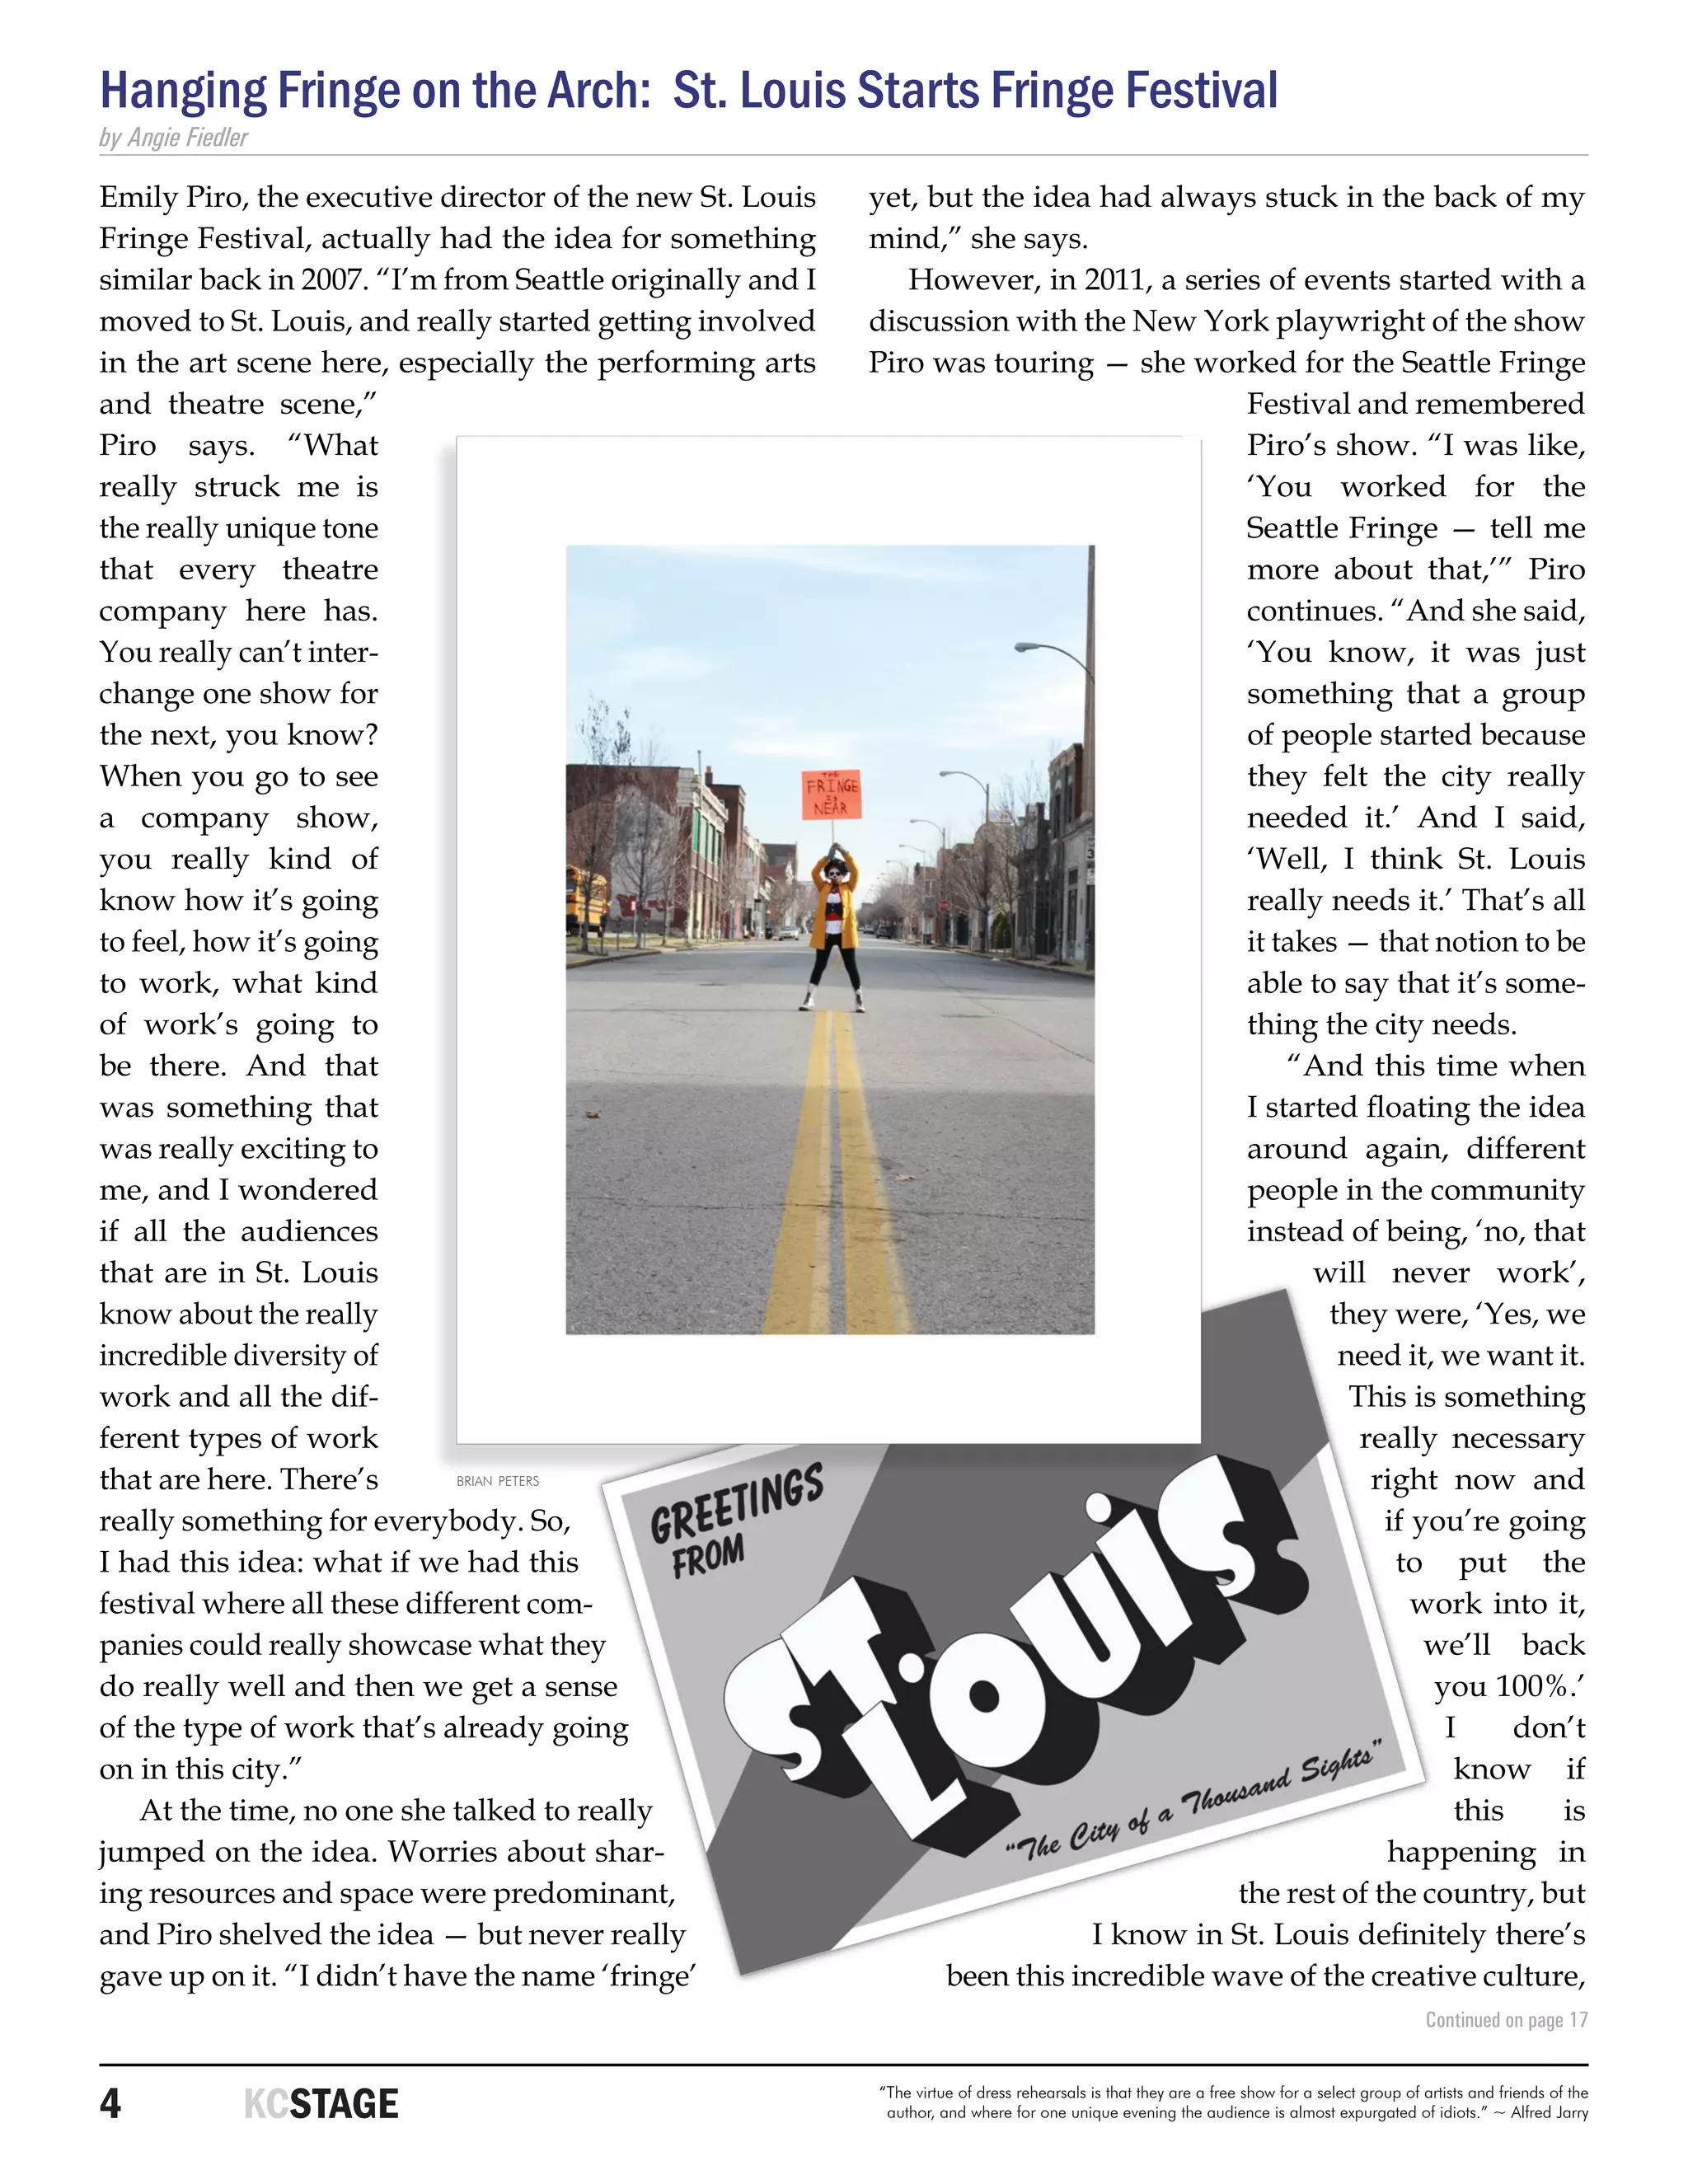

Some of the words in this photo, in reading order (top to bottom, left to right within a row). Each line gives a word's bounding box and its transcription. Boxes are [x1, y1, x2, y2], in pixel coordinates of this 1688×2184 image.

[102, 70, 268, 119] Hanging
[279, 70, 401, 119] Fringe
[412, 78, 460, 109] on
[472, 70, 537, 109] the
[546, 70, 649, 109] Arch:
[673, 69, 726, 109] St.
[742, 70, 846, 109] Louis
[857, 69, 980, 109] Starts
[993, 70, 1114, 119] Fringe
[1128, 69, 1277, 109] Festival
[98, 126, 124, 152] by
[126, 126, 181, 152] Angie
[185, 126, 250, 148] Fiedler
[99, 184, 180, 216] Emily
[186, 185, 249, 212] Piro,
[256, 184, 299, 208] the
[306, 185, 433, 208] executive
[440, 184, 546, 208] director
[553, 184, 580, 208] of
[587, 184, 629, 209] the
[635, 191, 694, 208] new
[700, 185, 733, 208] St.
[741, 185, 816, 208] Louis
[971, 225, 1016, 250] she
[1024, 233, 1088, 258] says.
[99, 433, 157, 457] Piro
[189, 440, 255, 465] says.
[1336, 432, 1417, 457] show.
[1463, 440, 1518, 457] was
[1527, 432, 1586, 460] like,
[1247, 564, 1320, 580] more
[1334, 556, 1414, 580] about
[1528, 557, 1586, 580] Piro
[99, 640, 152, 663] You
[158, 639, 233, 671] really
[307, 640, 379, 663] inter-
[807, 779, 860, 794] FRINGE
[100, 812, 115, 828] a
[141, 812, 270, 837] company
[297, 804, 378, 832] show,
[814, 802, 848, 815] NEAR
[1247, 804, 1348, 828] needed
[1416, 804, 1478, 828] And
[1494, 805, 1505, 828] I
[1522, 804, 1586, 832] said,
[99, 973, 126, 994] to
[138, 970, 219, 998] work,
[232, 970, 303, 994] what
[315, 970, 378, 994] kind
[1247, 1011, 1319, 1043] thing
[1325, 1011, 1368, 1035] the
[1375, 1012, 1425, 1043] city
[1432, 1011, 1517, 1035] needs.
[1247, 1136, 1348, 1160] around
[1366, 1137, 1449, 1168] again,
[1466, 1135, 1587, 1160] different
[99, 1184, 149, 1205] me,
[158, 1177, 210, 1201] and
[219, 1178, 229, 1201] I
[237, 1177, 378, 1201] wondered
[1312, 1259, 1367, 1283] will
[1392, 1267, 1471, 1284] never
[1348, 1384, 1407, 1408] This
[1414, 1385, 1437, 1408] is
[1444, 1384, 1587, 1416] something
[99, 1466, 152, 1491] that
[159, 1474, 200, 1490] are
[207, 1466, 272, 1491] here.
[457, 1475, 493, 1487] BRIAN
[499, 1475, 540, 1487] PETERS
[650, 1460, 824, 1545] GREETINGS
[671, 1531, 745, 1581] FROM
[1409, 1591, 1483, 1615] work
[1493, 1591, 1548, 1615] into
[1559, 1591, 1586, 1619] it,
[1433, 1680, 1488, 1705] you
[1069, 1821, 1121, 1852] City
[1128, 1807, 1151, 1836] of
[1157, 1807, 1175, 1823] a
[1180, 1766, 1292, 1815] Thousand
[99, 1881, 143, 1912] ing
[148, 1887, 275, 1905] resources
[282, 1880, 333, 1904] and
[340, 1887, 414, 1912] space
[420, 1887, 486, 1904] were
[493, 1880, 675, 1912] predominant,
[1092, 1922, 1103, 1945] I
[1111, 1921, 1189, 1946] know
[1196, 1923, 1224, 1945] in
[1231, 1922, 1264, 1946] St.
[1273, 1922, 1349, 1946] Louis
[1358, 1921, 1487, 1954] definitely
[1426, 2011, 1500, 2028] Continued
[1506, 2015, 1523, 2028] on
[1528, 2015, 1564, 2032] page
[1570, 2011, 1588, 2028] 17
[100, 2087, 122, 2119] 4
[916, 2086, 954, 2099] virtue
[958, 2084, 973, 2099] of
[976, 2084, 1012, 2099] dress
[1016, 2084, 1086, 2099] rehearsals
[1091, 2086, 1101, 2099] is
[1105, 2084, 1132, 2099] that
[1136, 2084, 1165, 2102] they
[1168, 2089, 1192, 2099] are
[1195, 2089, 1205, 2099] a
[1209, 2084, 1236, 2099] free
[1240, 2084, 1276, 2099] show
[1279, 2084, 1300, 2099] for
[1303, 2089, 1312, 2099] a
[1317, 2084, 1357, 2099] select
[1360, 2089, 1402, 2102] group
[1405, 2084, 1421, 2099] of
[1424, 2086, 1464, 2099] artists
[1468, 2084, 1494, 2099] and
[1498, 2084, 1545, 2099] friends
[1549, 2084, 1564, 2099] of
[1567, 2084, 1589, 2099] the
[887, 2104, 935, 2121] author,
[940, 2104, 966, 2119] and
[970, 2104, 1012, 2119] where
[1016, 2104, 1037, 2119] for
[1040, 2109, 1067, 2119] one
[1071, 2106, 1118, 2122] unique
[1123, 2106, 1176, 2122] evening
[1180, 2104, 1203, 2119] the
[1207, 2104, 1270, 2119] audience
[1275, 2106, 1285, 2119] is
[1289, 2104, 1336, 2119] almost
[1339, 2104, 1417, 2123] expurgated
[1421, 2104, 1436, 2119] of
[1510, 2104, 1551, 2119] Alfred
[1555, 2105, 1589, 2122] Jarry
